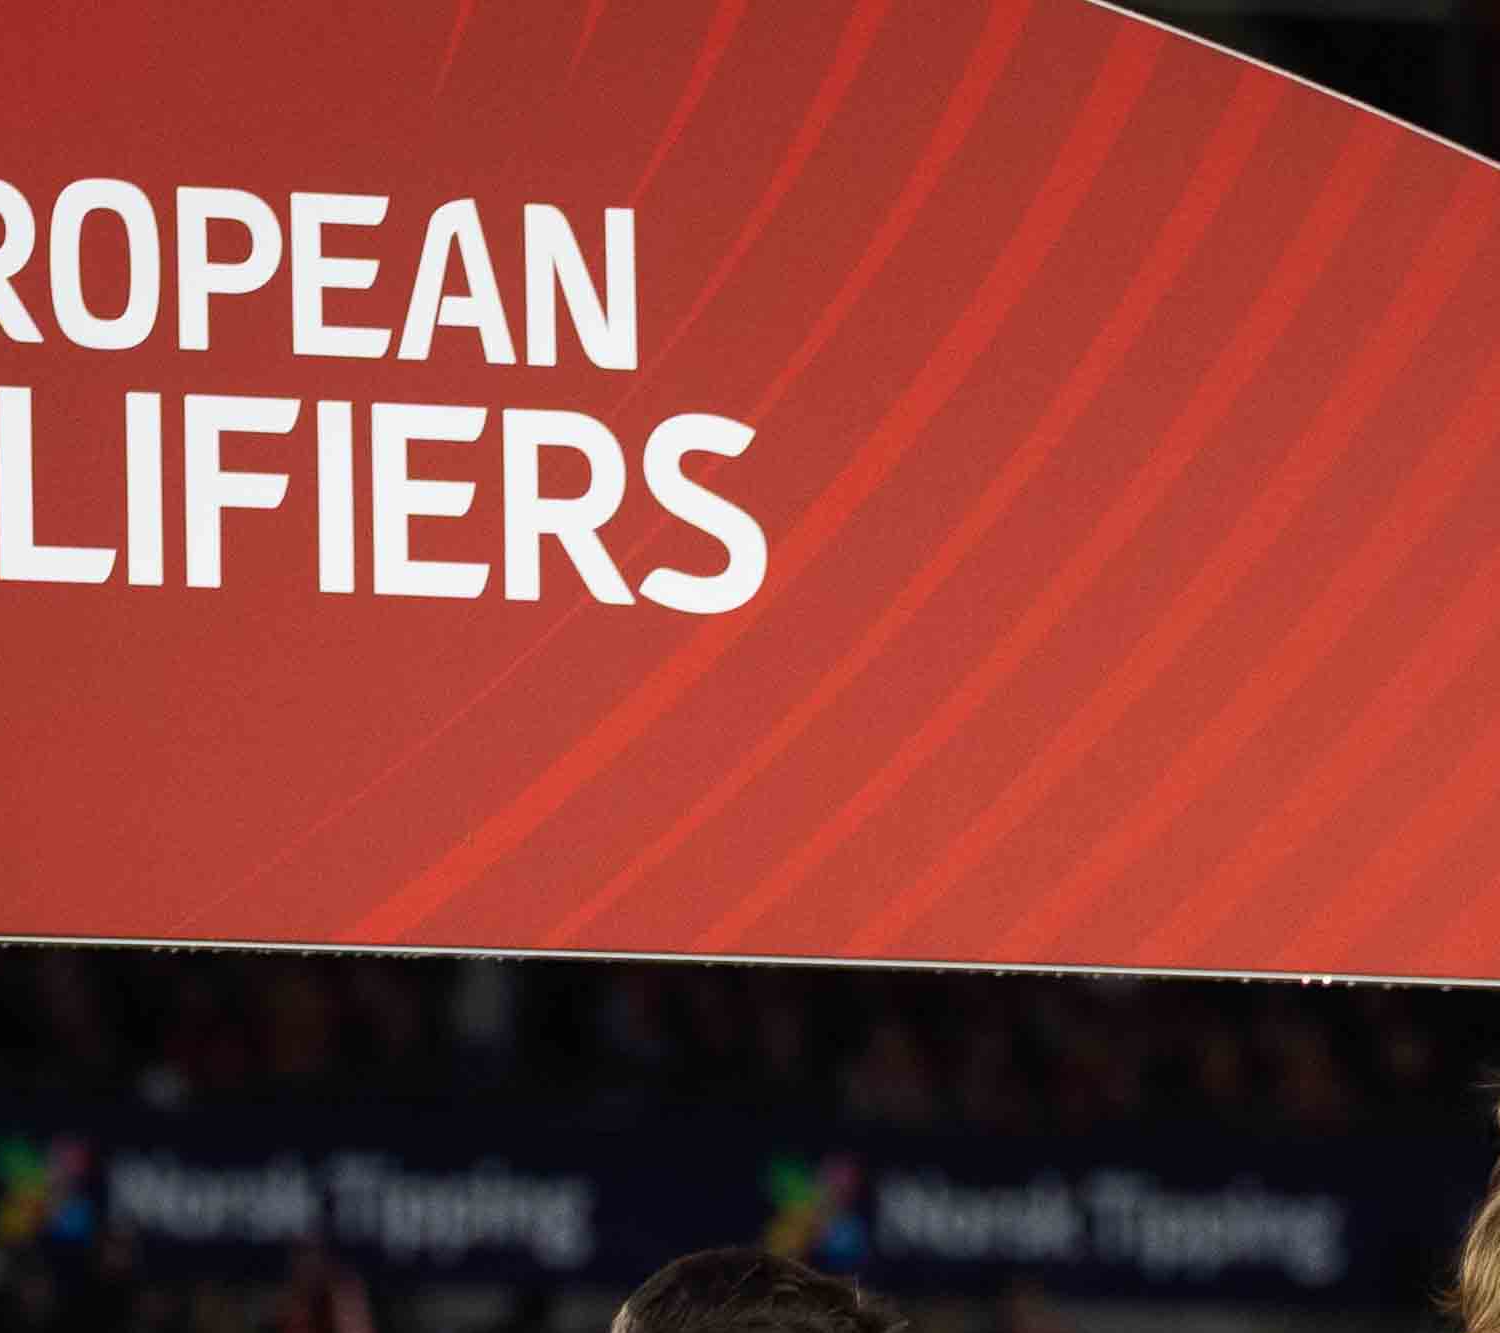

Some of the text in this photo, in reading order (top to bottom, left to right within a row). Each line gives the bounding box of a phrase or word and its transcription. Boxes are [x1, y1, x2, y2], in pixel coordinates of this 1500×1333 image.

[105, 1148, 598, 1268] Norsk Tipping
[876, 1168, 1348, 1286] Norsk Tipping
